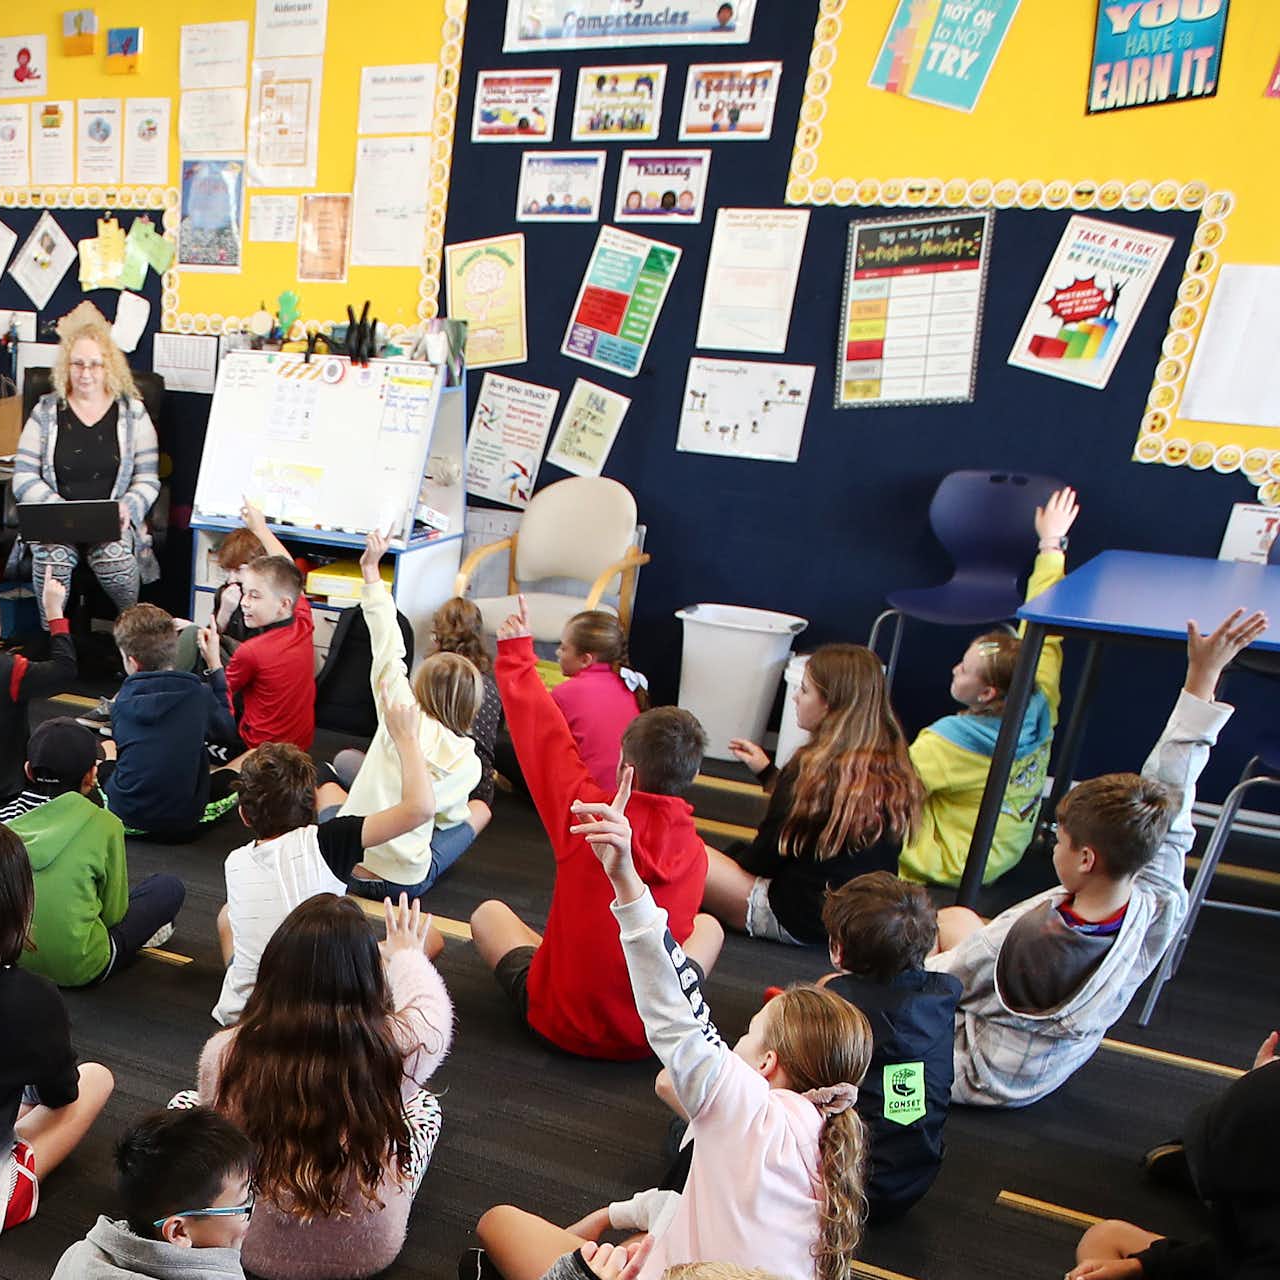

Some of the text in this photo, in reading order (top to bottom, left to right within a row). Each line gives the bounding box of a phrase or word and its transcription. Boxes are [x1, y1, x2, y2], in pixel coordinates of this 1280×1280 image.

[942, 2, 997, 29] NOT OK
[1105, 0, 1220, 36] YOU
[952, 25, 988, 50] NOT
[1124, 29, 1174, 57] HAVE
[926, 41, 980, 80] TRY.
[1089, 45, 1217, 112] EARN IT.
[698, 99, 756, 112] to Others
[636, 162, 692, 180] Thinking
[1076, 229, 1158, 259] TAKE A RISK!
[1087, 256, 1147, 280] RESILIENT!
[506, 384, 522, 395] you
[888, 1099, 922, 1110] CONSET
